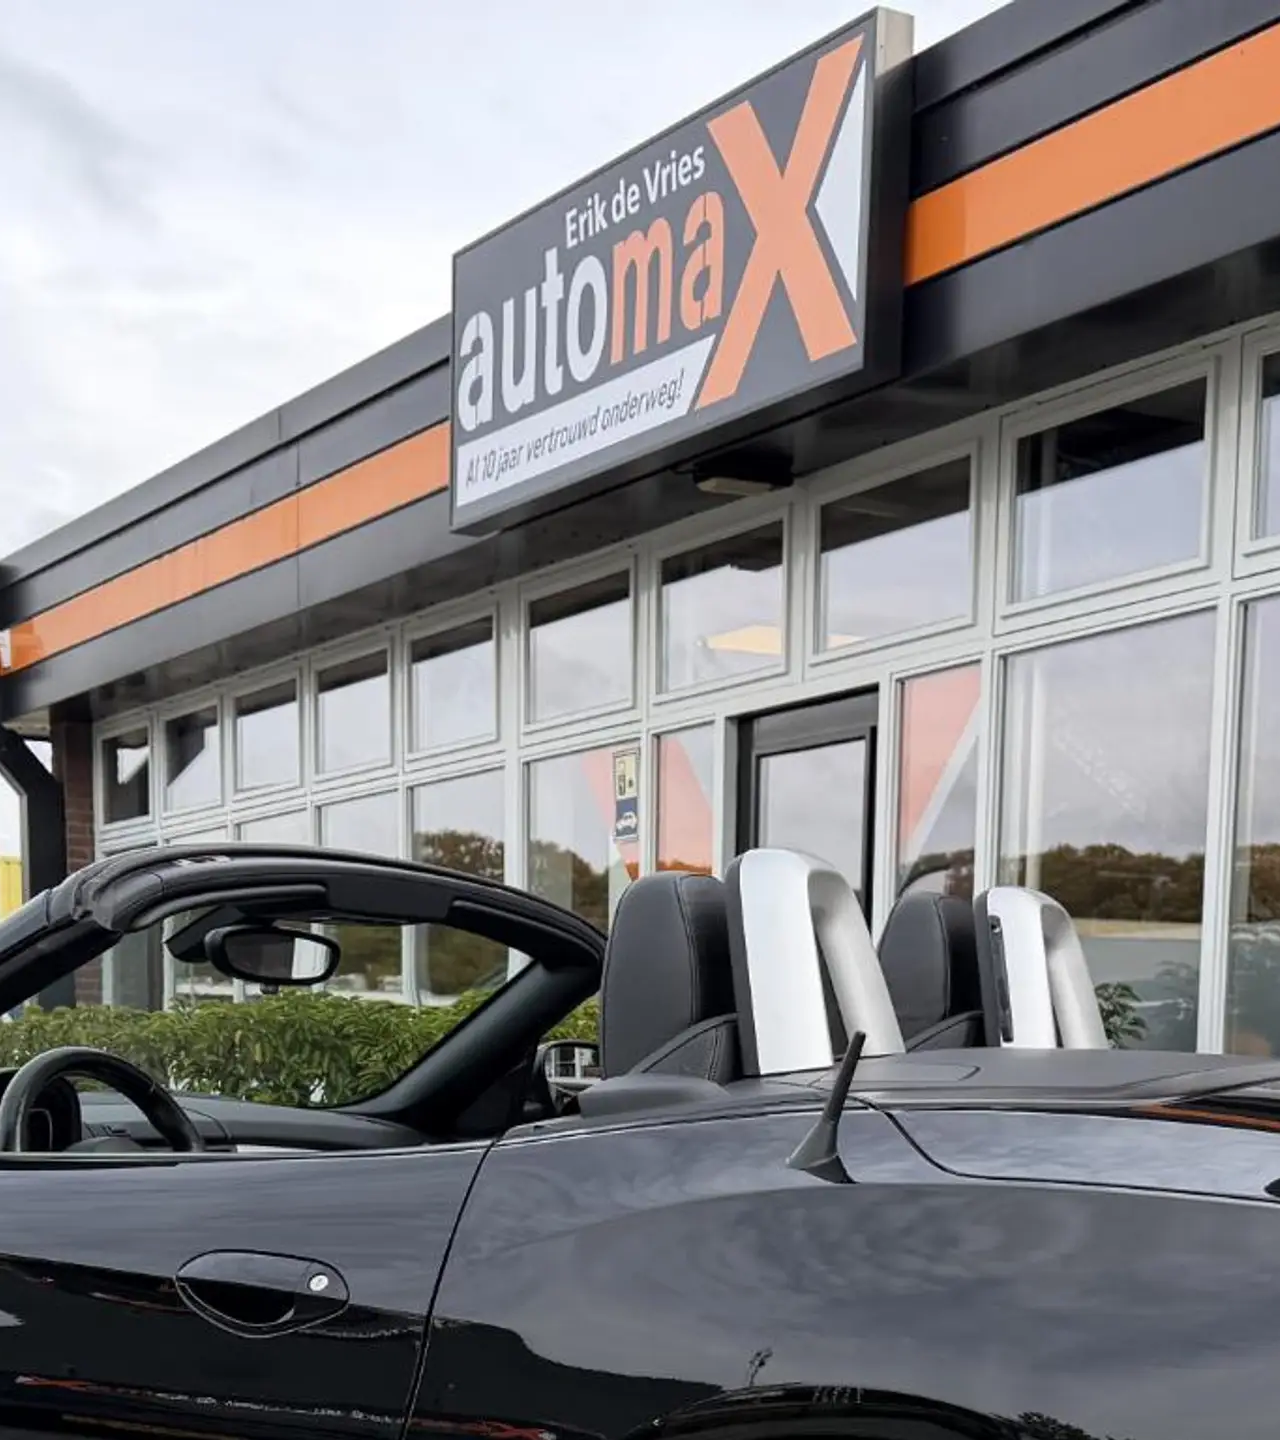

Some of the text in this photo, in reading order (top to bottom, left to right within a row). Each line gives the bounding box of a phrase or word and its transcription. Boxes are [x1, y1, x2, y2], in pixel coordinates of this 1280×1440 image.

[565, 146, 706, 249] Erik de Vries
[496, 444, 524, 481] jaar
[525, 406, 602, 463] vertrouwd
[601, 368, 686, 428] onderweg!
